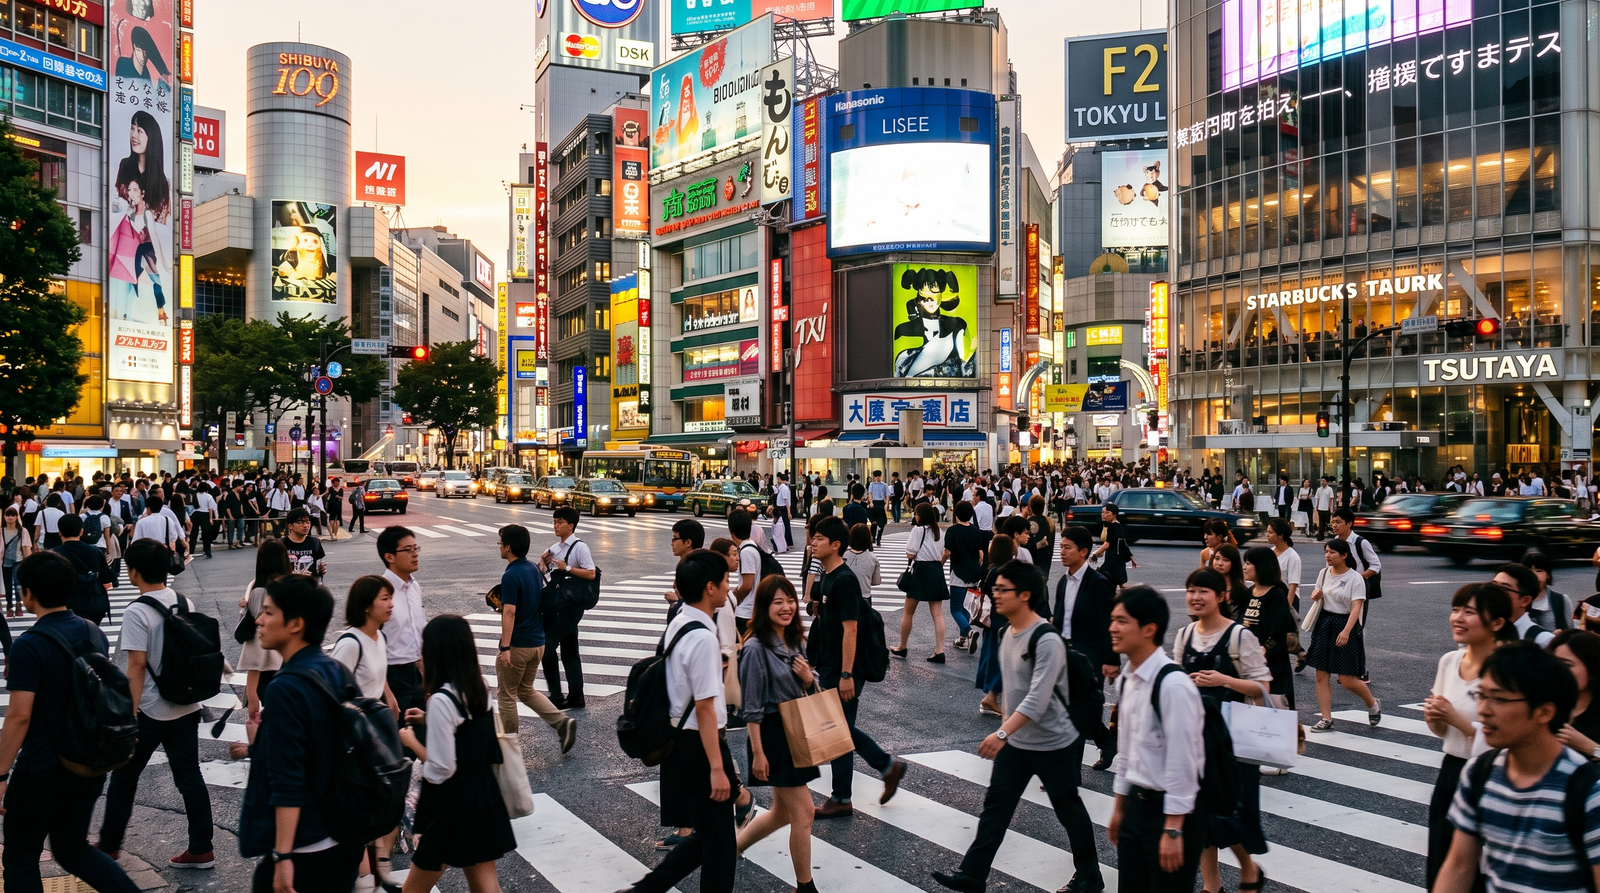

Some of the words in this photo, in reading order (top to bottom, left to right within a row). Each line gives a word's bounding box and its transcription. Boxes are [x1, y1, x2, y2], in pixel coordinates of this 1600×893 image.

[620, 46, 649, 61] DSK
[1103, 44, 1167, 96] F2
[272, 67, 340, 107] 109
[882, 116, 930, 134] LISEE
[1073, 103, 1148, 127] TOKYU
[1246, 282, 1358, 310] STARBUCKS
[1365, 273, 1444, 297] TAURK
[1423, 354, 1559, 382] TSUTAYA
